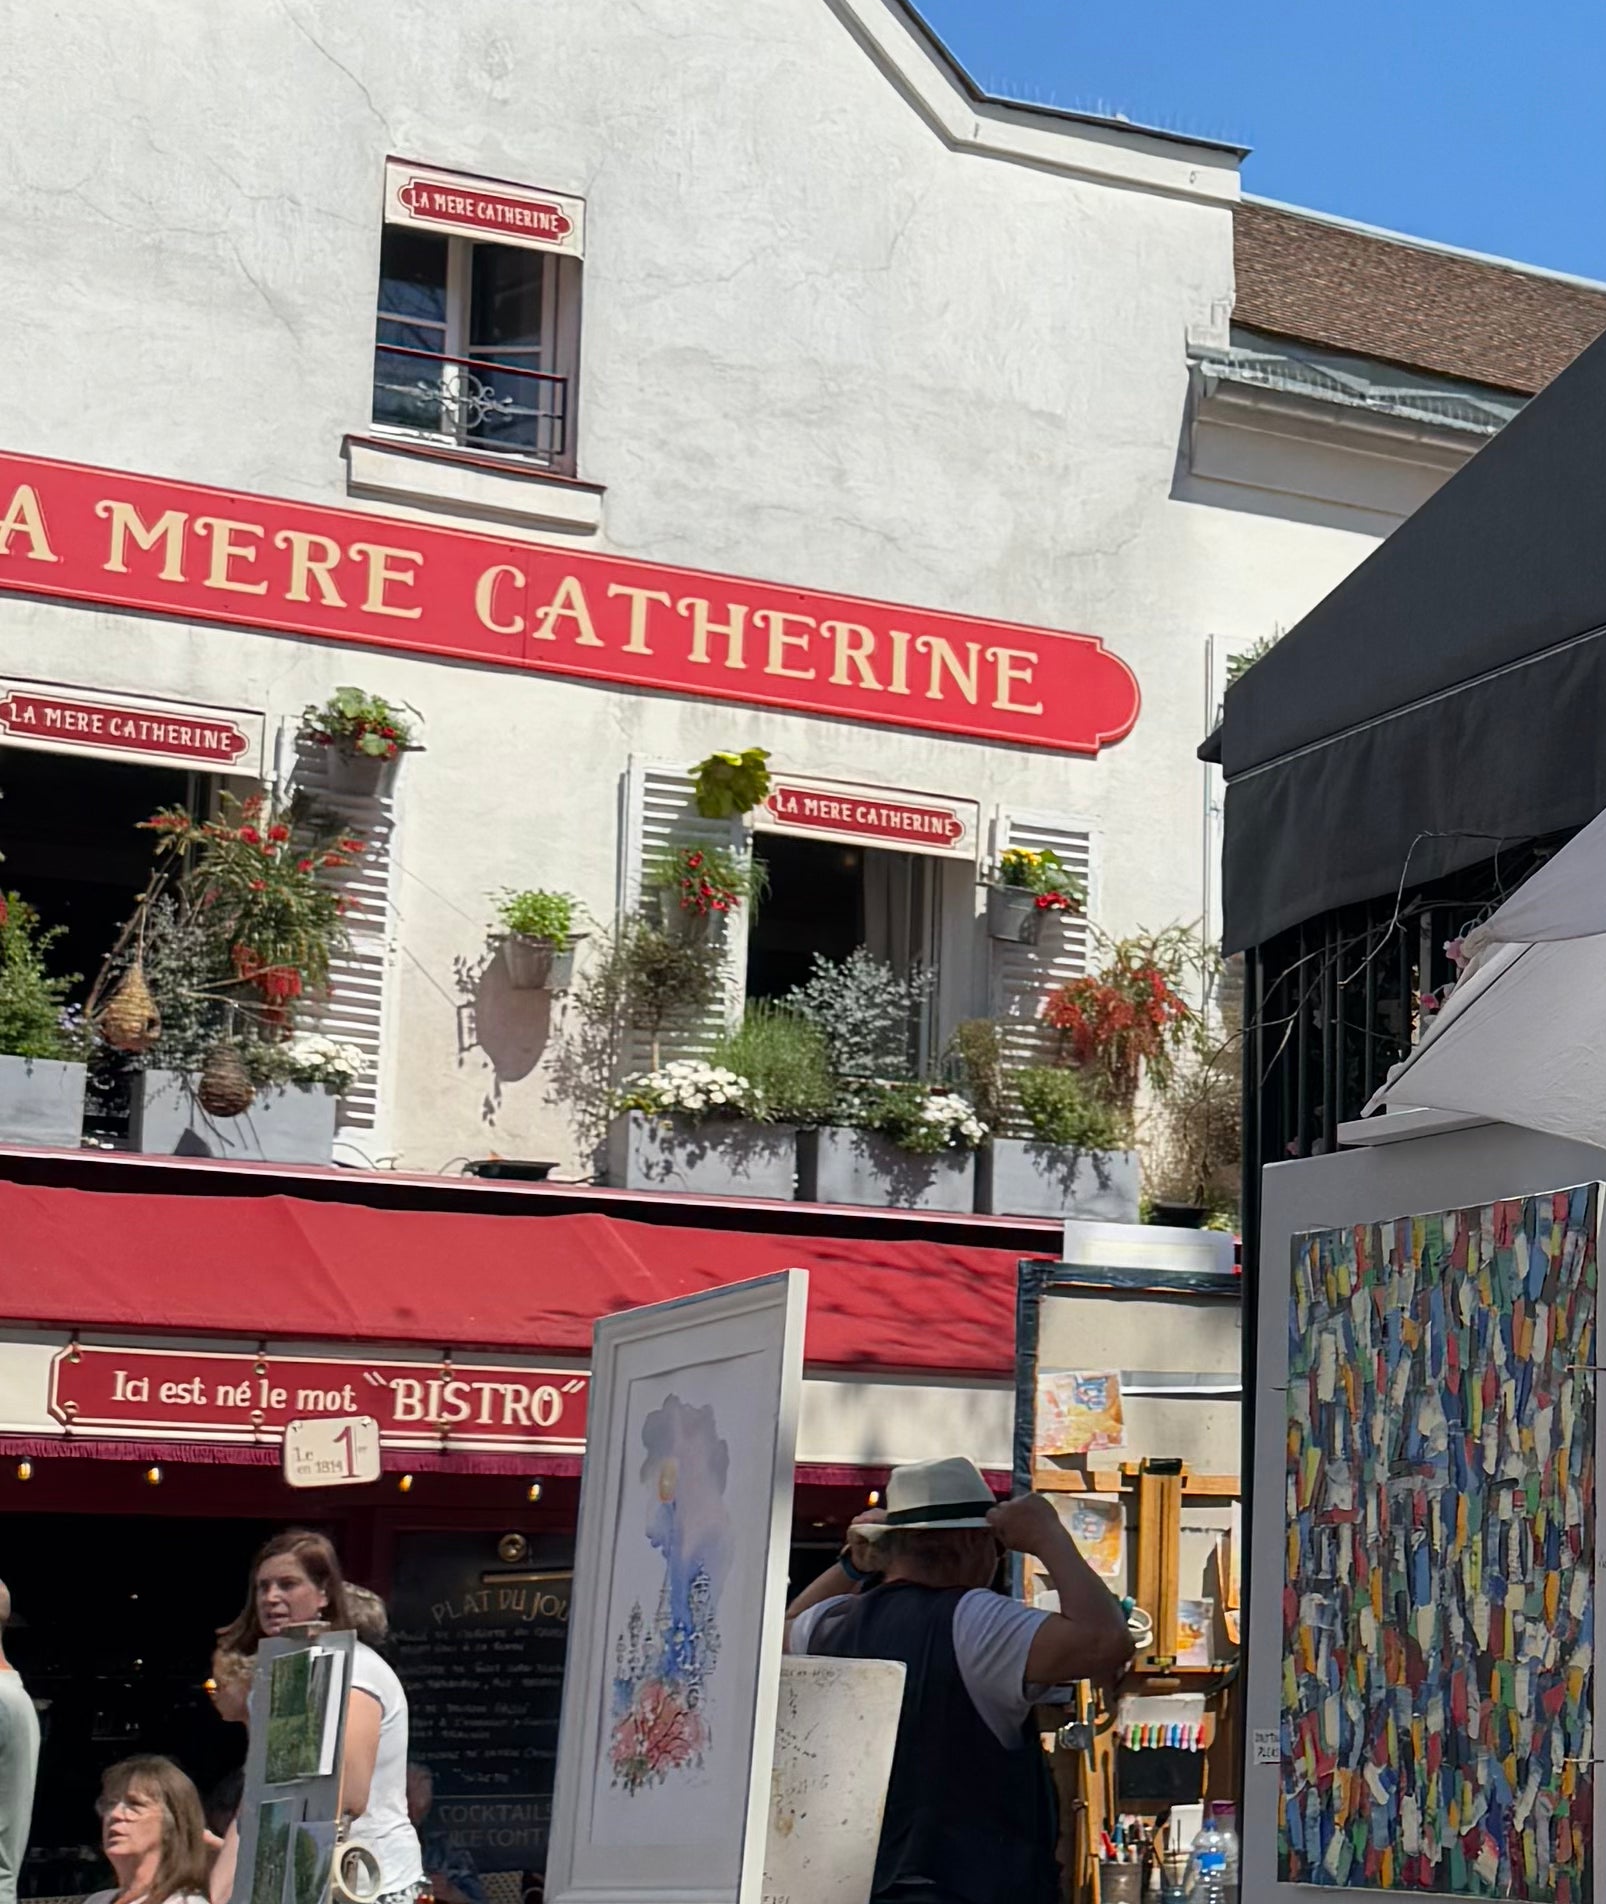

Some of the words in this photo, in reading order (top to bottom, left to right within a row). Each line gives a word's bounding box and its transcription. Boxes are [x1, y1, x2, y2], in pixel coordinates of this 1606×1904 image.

[410, 189, 430, 209] LA
[433, 193, 475, 217] MERE
[477, 201, 560, 232] CATHERINE
[0, 484, 59, 563] A
[95, 499, 425, 620] MERE
[474, 564, 1044, 716] CATHERINE
[9, 702, 37, 723] LA
[44, 707, 104, 734] MERE
[109, 717, 232, 751] CATHERINE
[776, 795, 798, 813] LA
[804, 798, 852, 822] MERE
[856, 806, 955, 836] CATHERINE
[111, 1370, 150, 1402] Ici
[159, 1377, 207, 1405] est
[215, 1380, 252, 1407] né
[258, 1379, 288, 1409] le
[296, 1384, 358, 1412] mot
[431, 1590, 493, 1624] PLAT
[499, 1589, 526, 1611] DU
[522, 1592, 569, 1622] JOU
